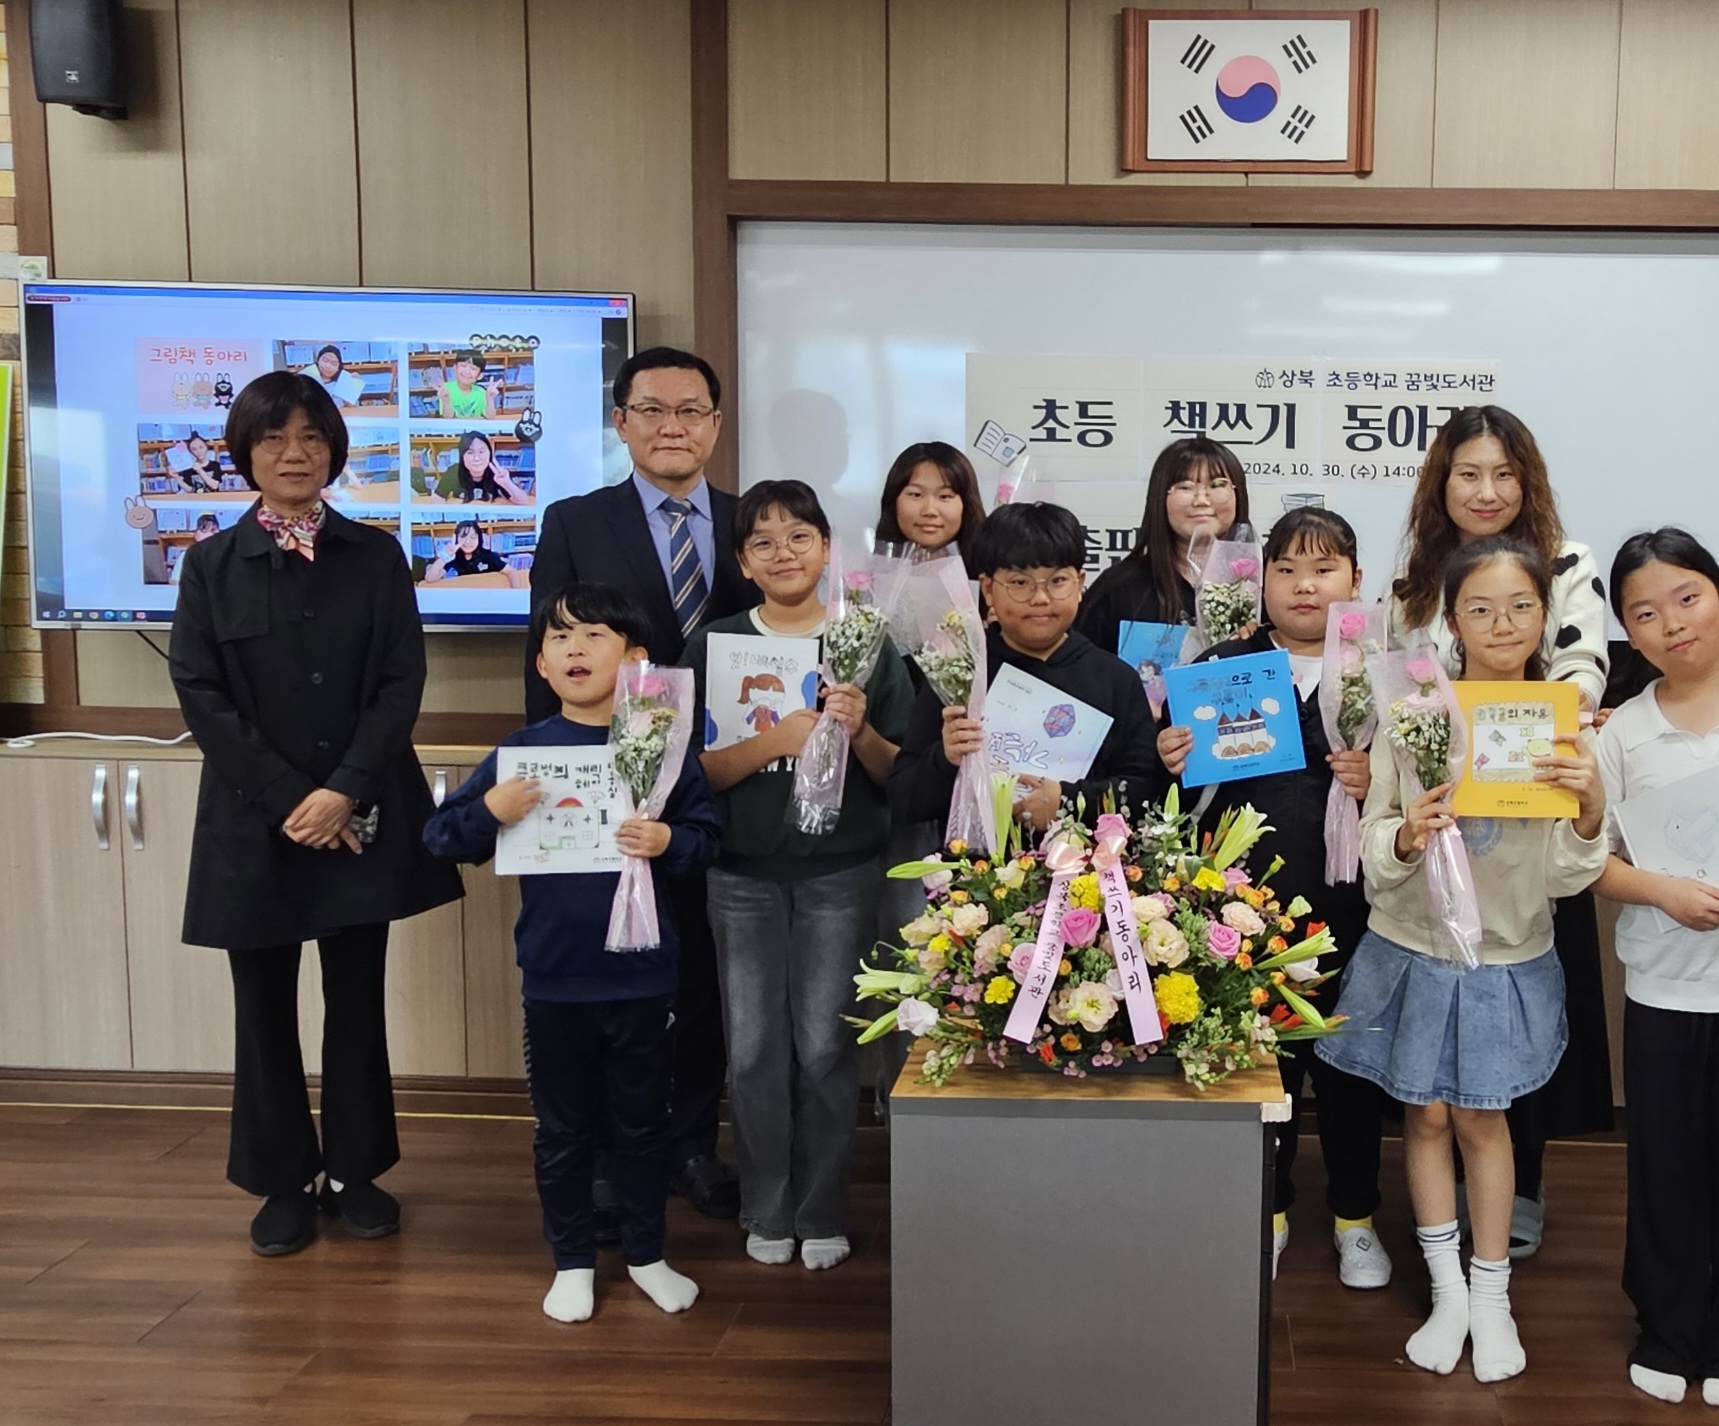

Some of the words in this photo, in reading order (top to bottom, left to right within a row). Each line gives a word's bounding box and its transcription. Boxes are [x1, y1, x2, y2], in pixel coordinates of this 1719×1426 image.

[150, 347, 197, 365] 그림책
[203, 346, 247, 366] 동아리
[1279, 369, 1315, 389] 상북
[1326, 370, 1399, 391] 초등학교
[1405, 372, 1496, 393] 꿈빛도서관
[1029, 398, 1117, 448] 초등
[1163, 400, 1297, 450] 책쓰기
[1342, 404, 1463, 452] 동아
[1243, 462, 1285, 477] 2024.
[1291, 463, 1313, 477] 10.
[1321, 463, 1345, 478] 30.
[1350, 463, 1377, 480] (수)
